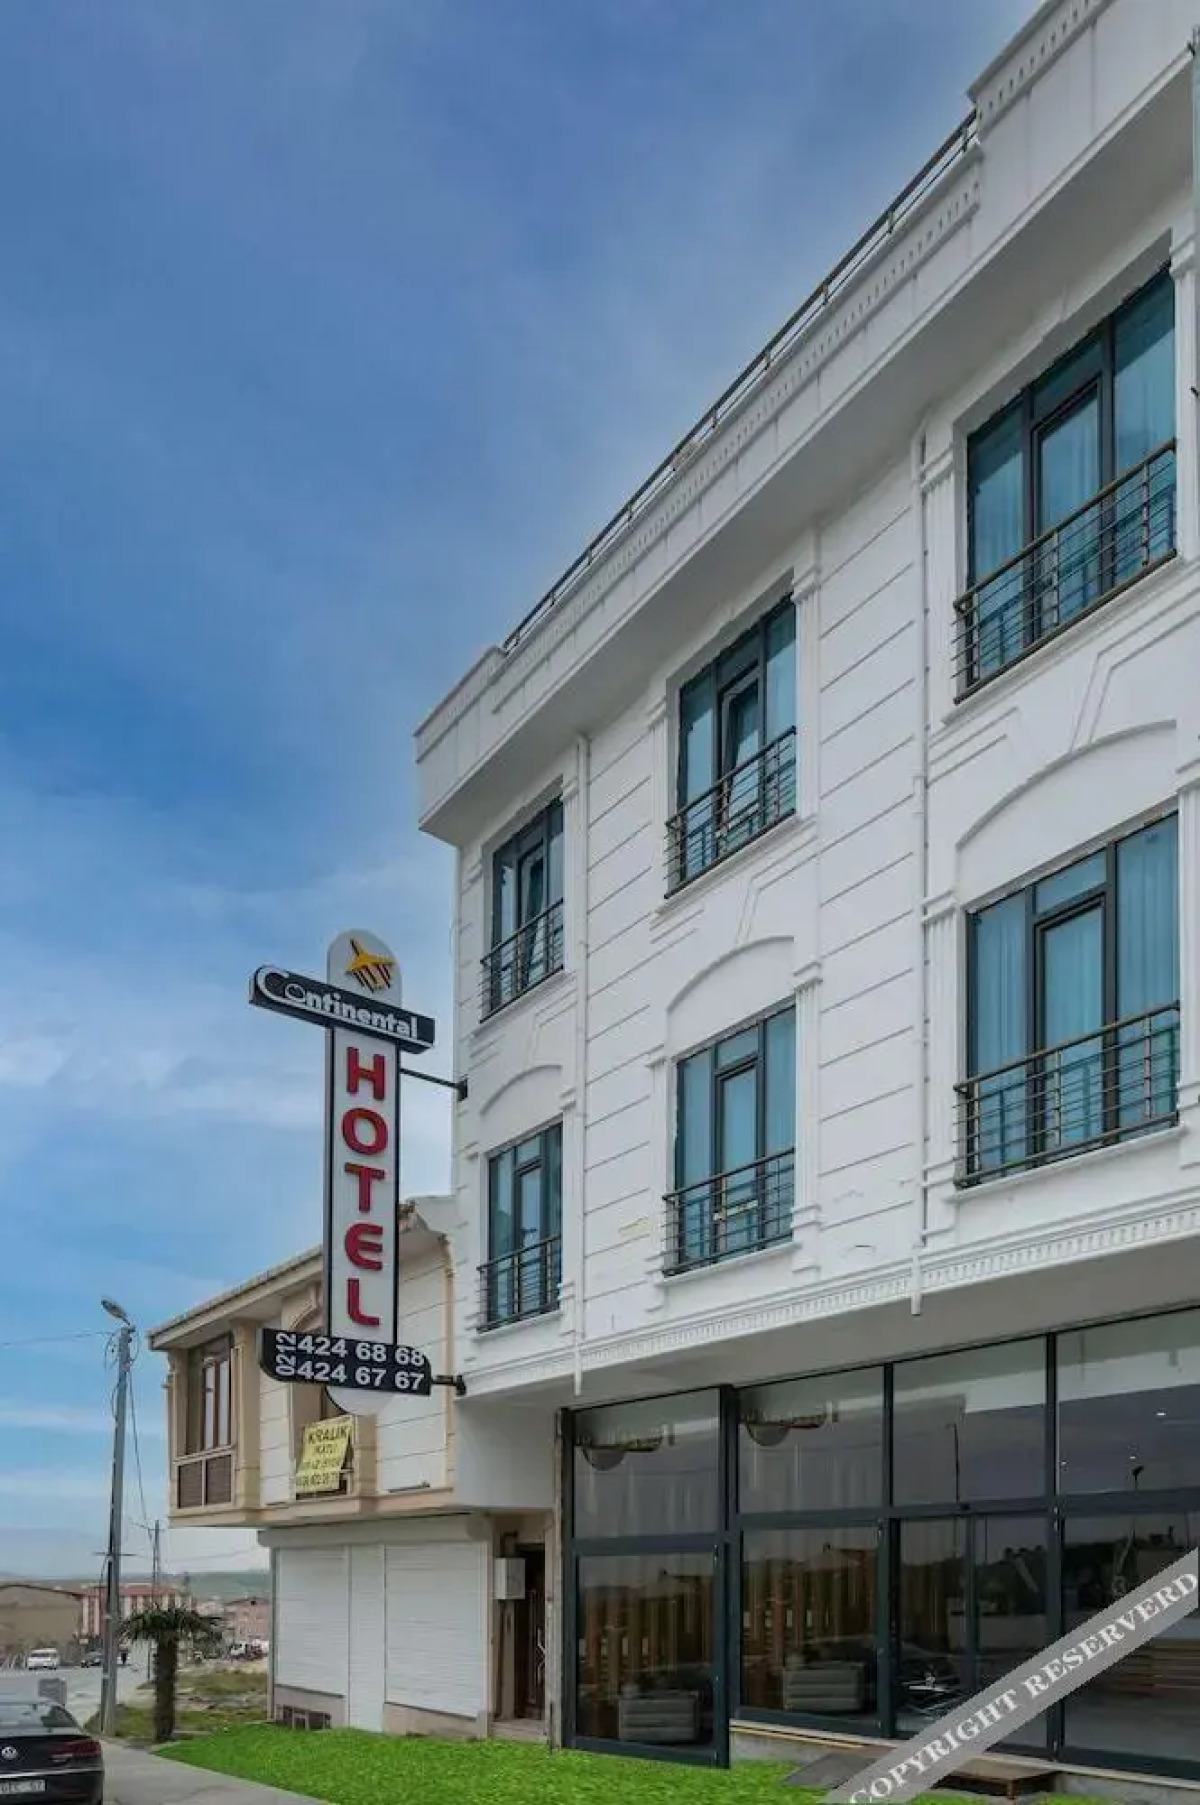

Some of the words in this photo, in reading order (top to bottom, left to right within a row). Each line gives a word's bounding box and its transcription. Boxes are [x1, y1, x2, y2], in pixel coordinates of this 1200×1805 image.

[256, 965, 418, 1039] Continental
[341, 1046, 389, 1328] HOTEL
[275, 1333, 297, 1376] 0212
[298, 1335, 348, 1358] 424
[355, 1342, 387, 1362] 68
[394, 1347, 425, 1367] 68
[298, 1360, 348, 1383] 424
[355, 1366, 387, 1387] 67
[394, 1371, 425, 1390] 67
